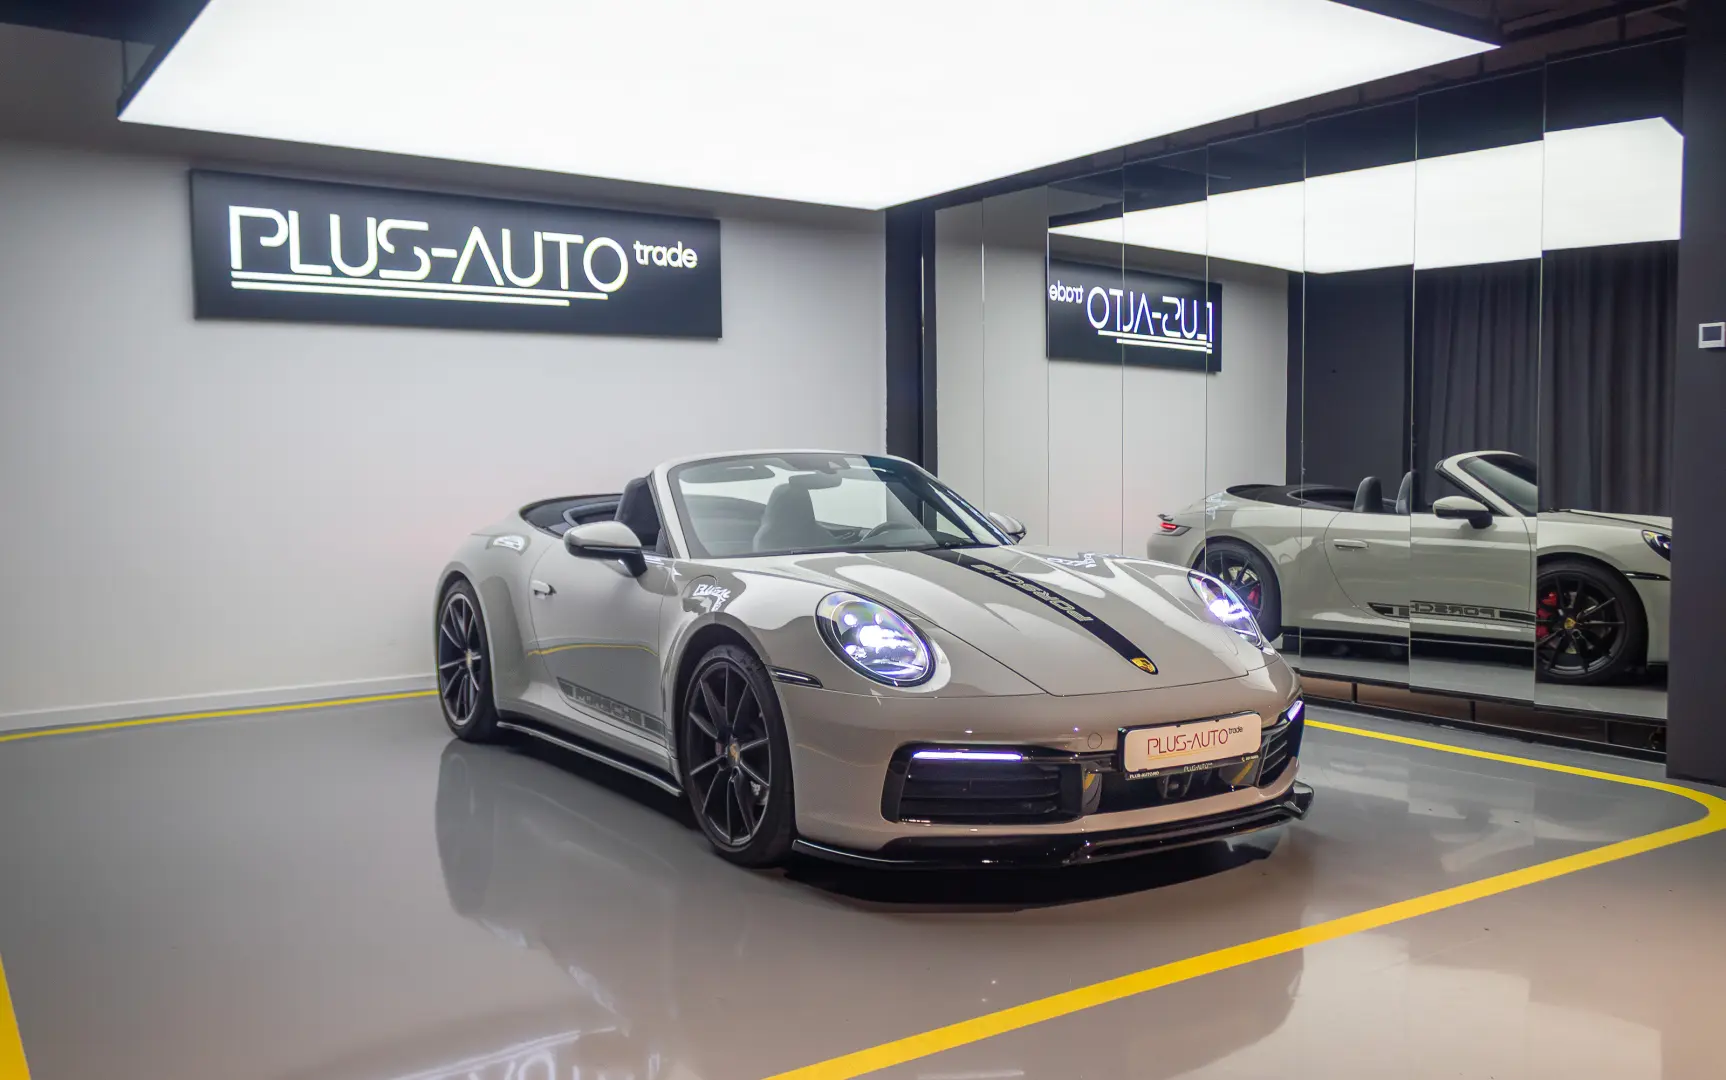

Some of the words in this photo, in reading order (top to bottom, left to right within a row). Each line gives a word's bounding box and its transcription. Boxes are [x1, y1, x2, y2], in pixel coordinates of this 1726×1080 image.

[229, 205, 628, 293] PLUS-AUTO
[633, 240, 698, 269] trade
[1147, 728, 1229, 755] PLUS-AUTO
[1229, 725, 1243, 735] trade
